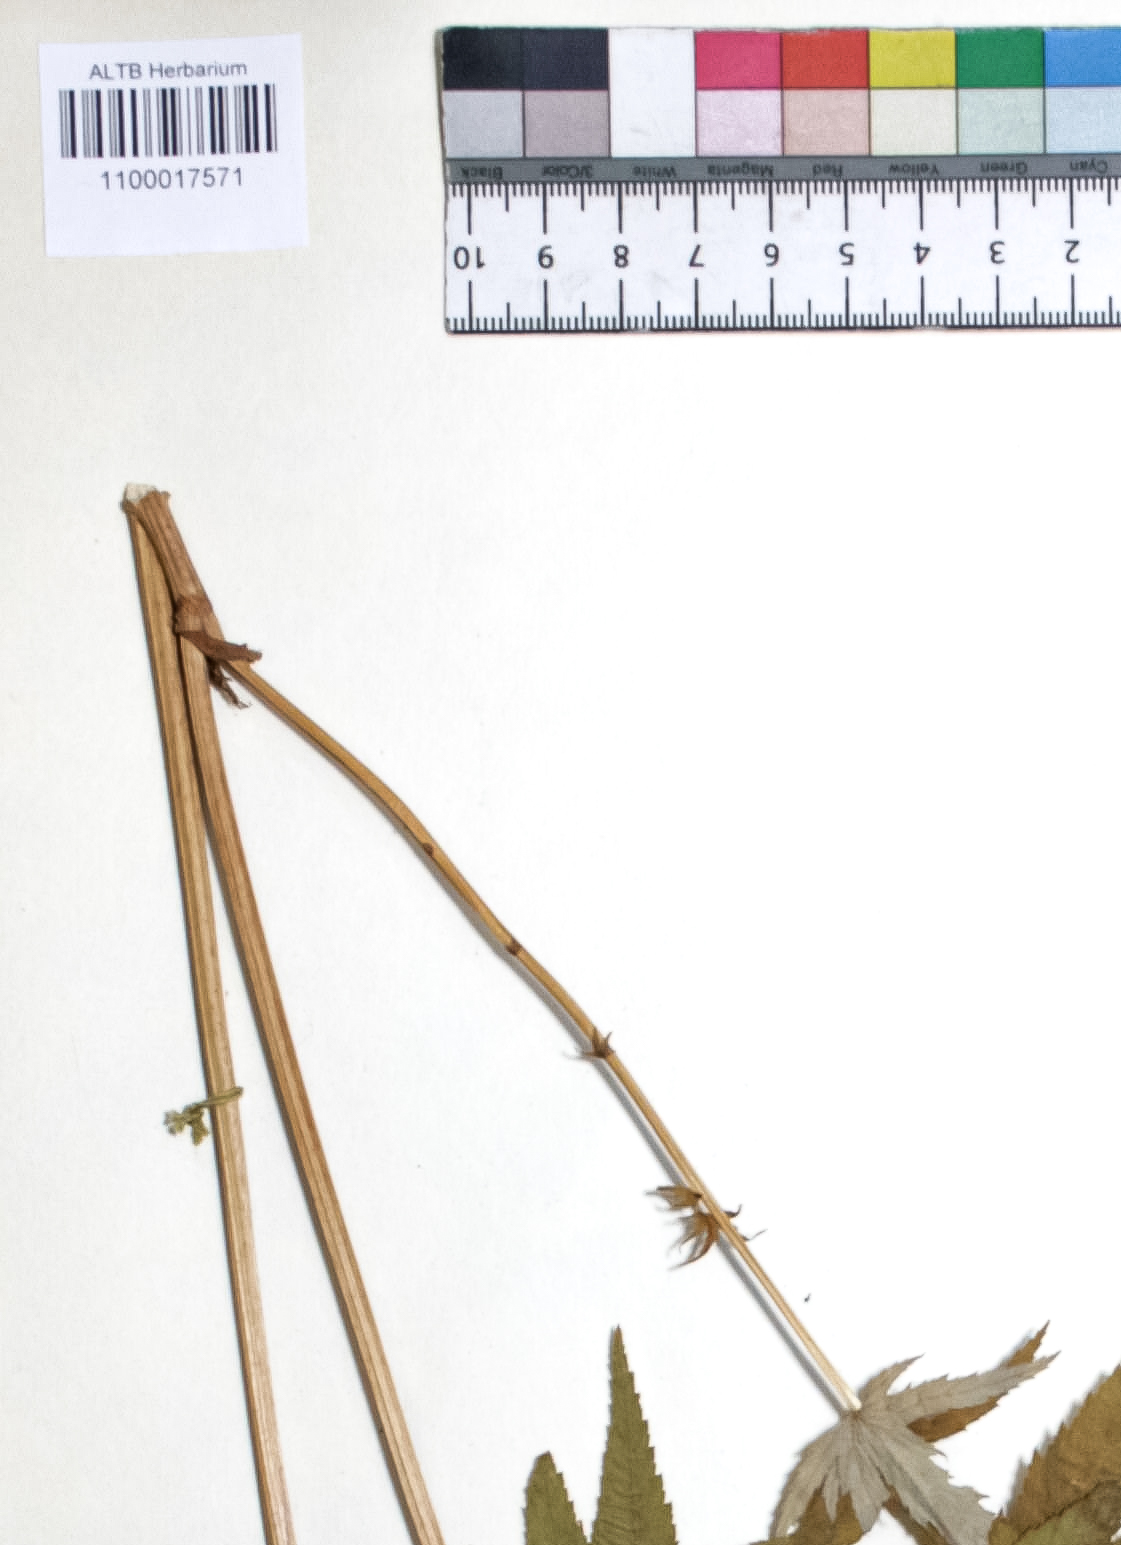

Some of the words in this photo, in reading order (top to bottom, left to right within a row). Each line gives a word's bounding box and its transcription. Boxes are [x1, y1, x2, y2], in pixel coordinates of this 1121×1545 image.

[89, 62, 142, 80] ALTB
[149, 60, 248, 79] Herbarium
[100, 166, 243, 190] 1100017571
[460, 166, 504, 180] Black
[633, 165, 678, 178] White
[707, 163, 776, 179] Magenta
[812, 163, 844, 177] Red
[888, 162, 941, 176] Yellow
[979, 160, 1029, 175] Green
[1068, 159, 1109, 174] Cyan
[453, 245, 486, 270] 10
[537, 244, 554, 269] 9
[613, 244, 630, 269] 8
[688, 243, 705, 268] 7
[763, 243, 780, 268] 6
[838, 242, 855, 266] 5
[913, 241, 931, 266] 4
[988, 240, 1006, 265] 3
[1064, 239, 1081, 264] 2
